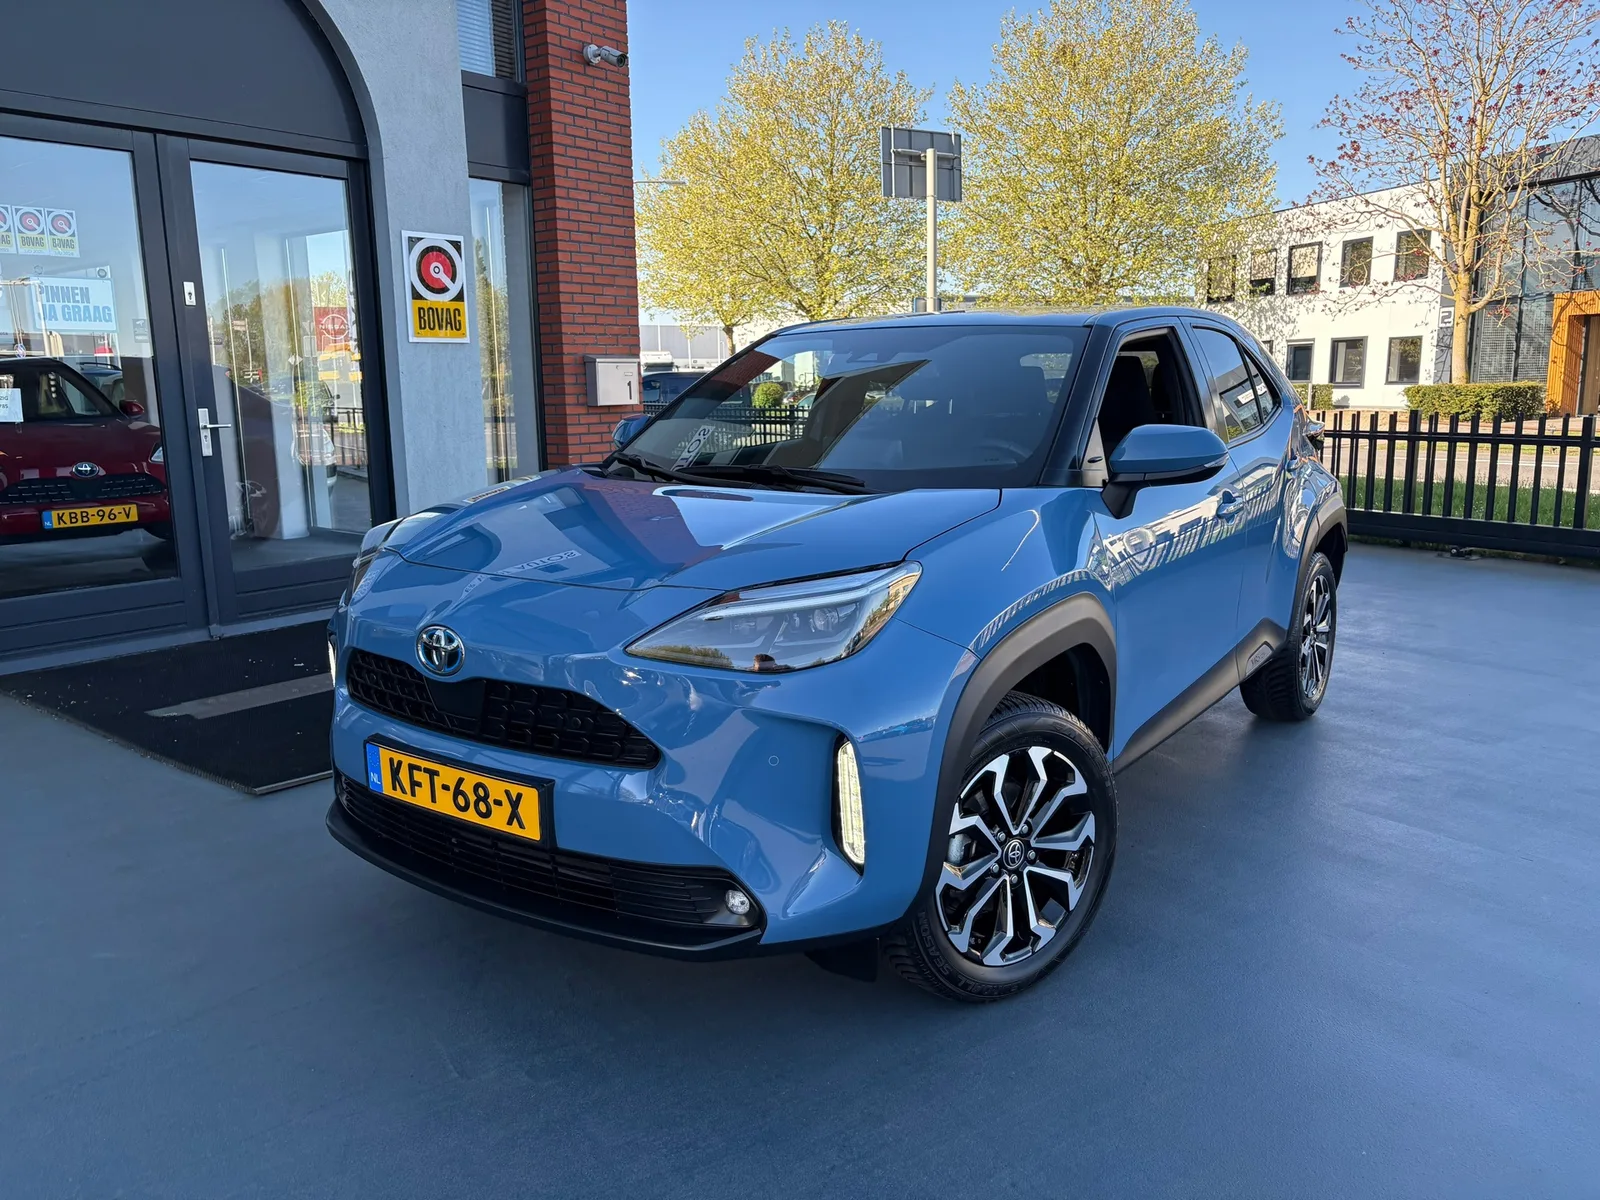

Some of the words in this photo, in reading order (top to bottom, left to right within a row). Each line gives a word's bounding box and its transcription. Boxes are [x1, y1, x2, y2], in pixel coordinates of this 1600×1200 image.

[21, 235, 45, 247] BOVAG
[52, 238, 75, 249] BOVAG
[63, 305, 113, 323] GRAAG
[418, 306, 462, 331] BOVAG
[1441, 310, 1452, 324] 2
[627, 380, 633, 400] 1
[57, 507, 132, 525] KBB-96-V
[370, 771, 381, 785] NL
[389, 757, 526, 829] KFT-68-X
